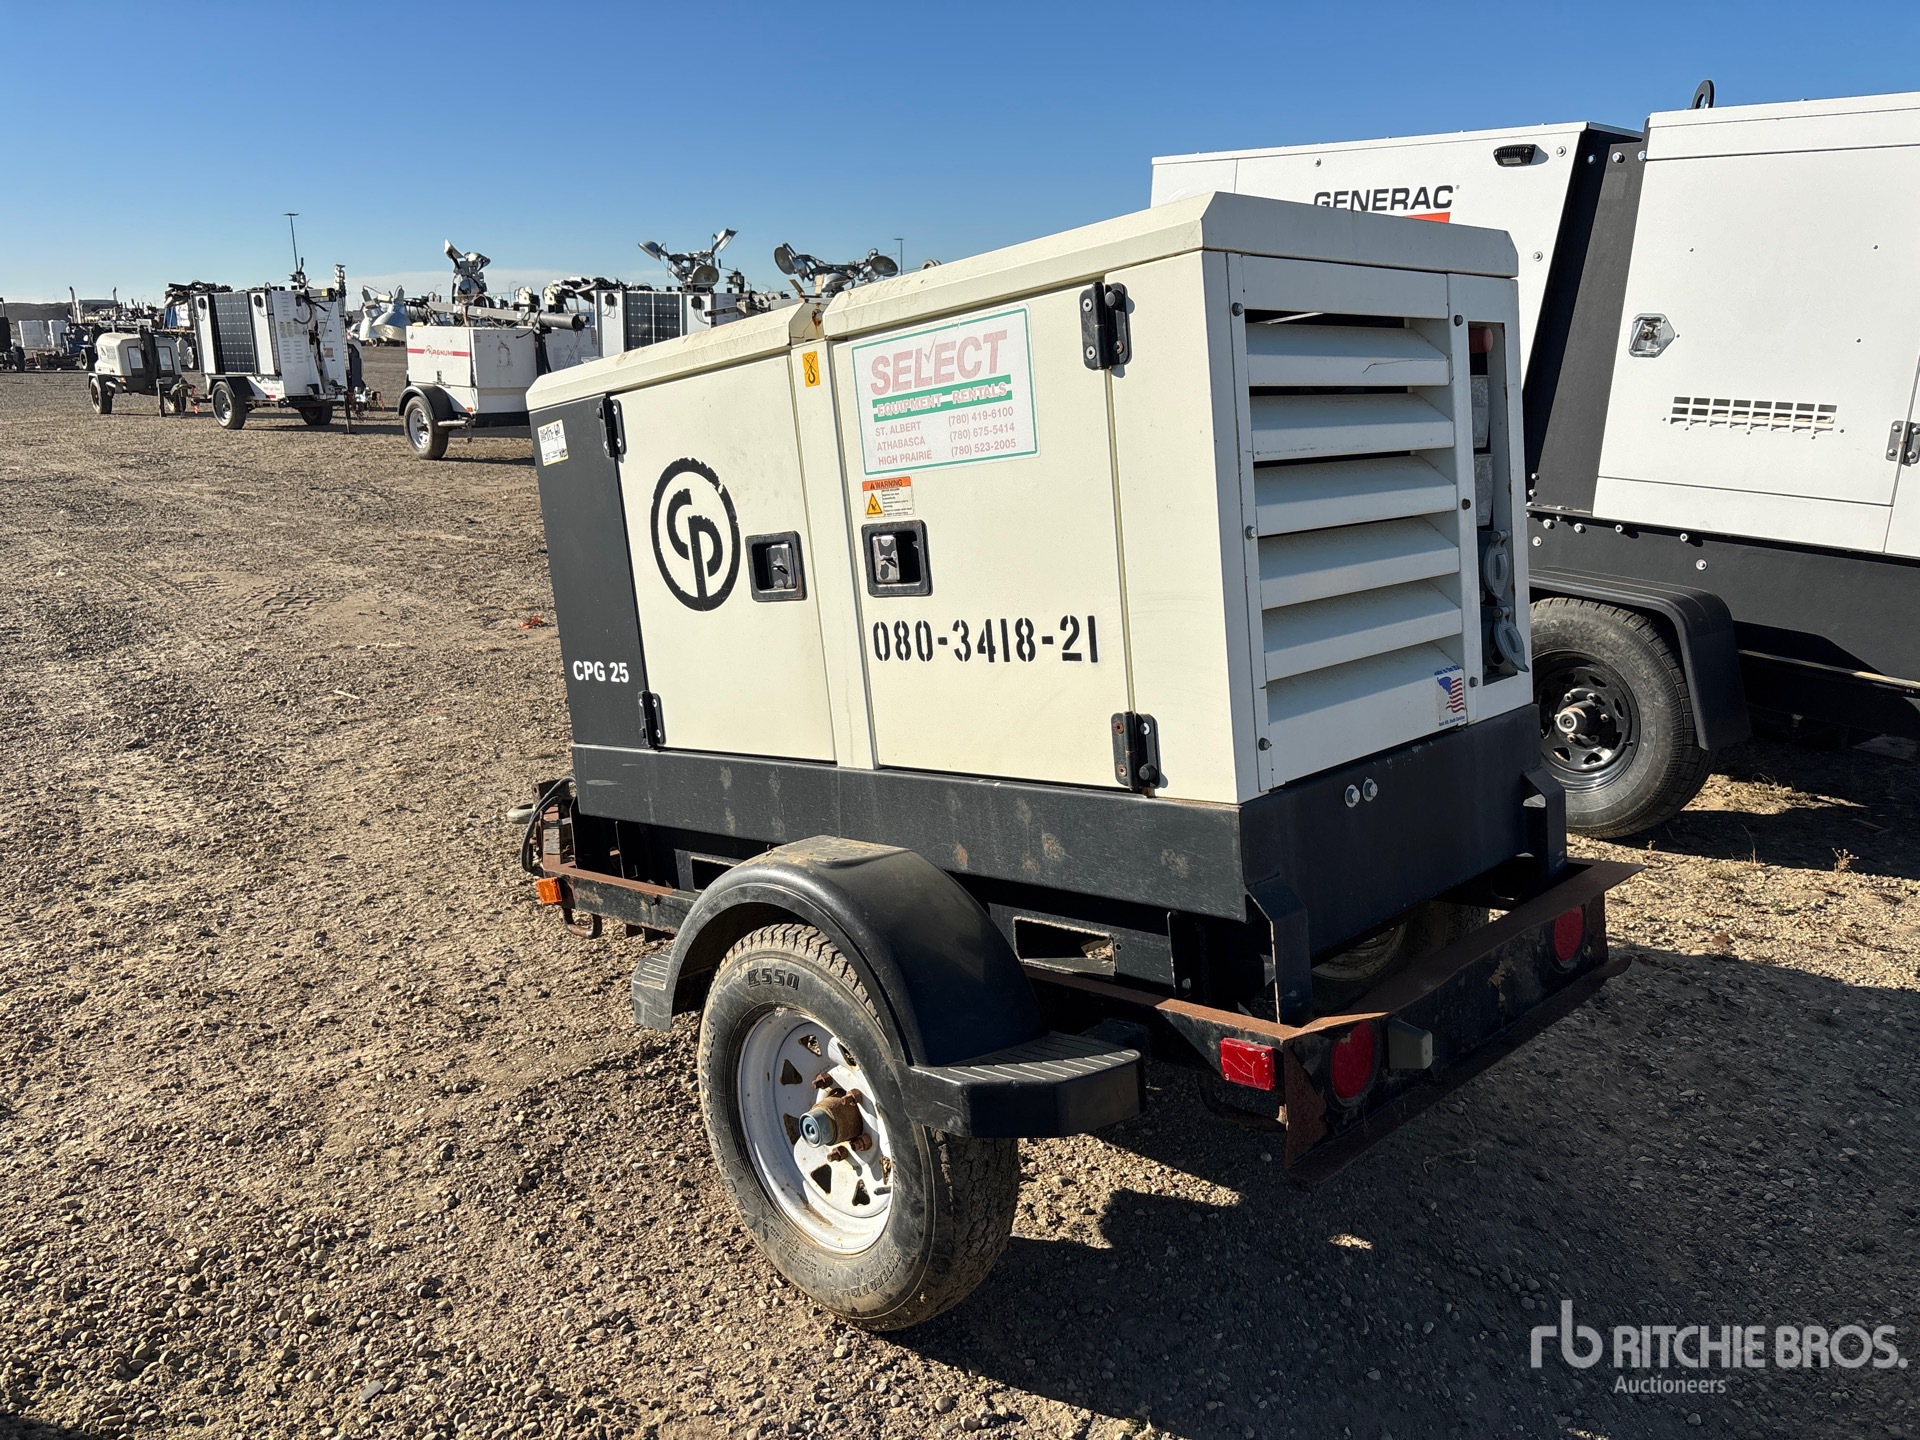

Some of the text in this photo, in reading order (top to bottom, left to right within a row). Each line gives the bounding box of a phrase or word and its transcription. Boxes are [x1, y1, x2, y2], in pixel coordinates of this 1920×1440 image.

[1314, 185, 1453, 212] GENERAC
[870, 330, 1008, 396] SELECT
[877, 382, 1008, 417] EQUIPMENT RENTALS
[875, 406, 1014, 437] ST. ALBERT (780) 419-6100
[877, 422, 1016, 452] ATHABASCA (780) 675-5414
[878, 438, 1017, 466] HIGH PRAIRIE (780) 523-2005
[875, 479, 903, 489] WARNING
[872, 614, 1099, 664] 080-3418-21
[573, 660, 630, 684] CPG 25
